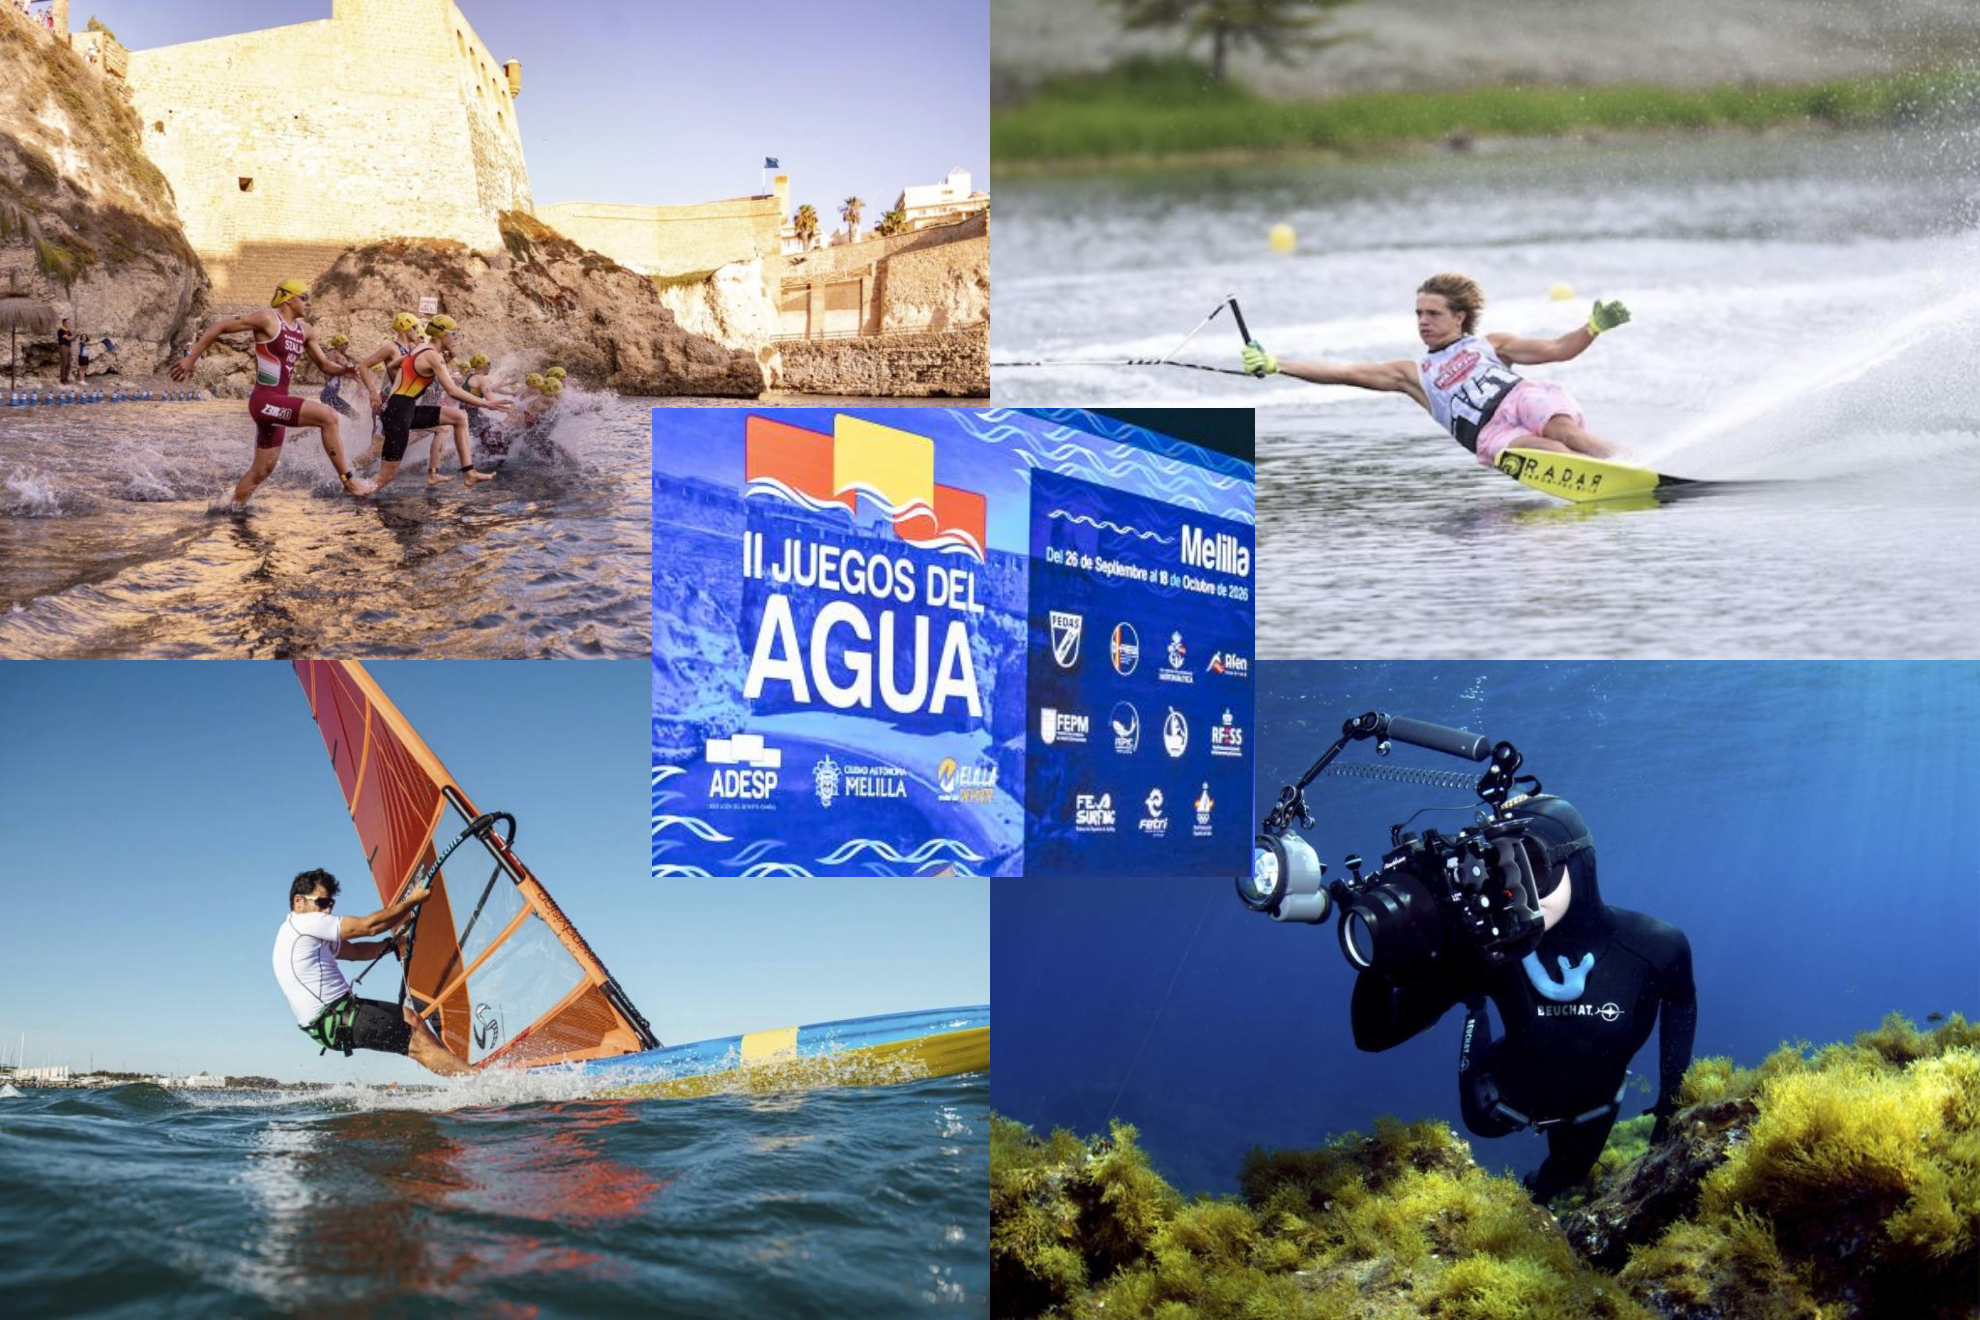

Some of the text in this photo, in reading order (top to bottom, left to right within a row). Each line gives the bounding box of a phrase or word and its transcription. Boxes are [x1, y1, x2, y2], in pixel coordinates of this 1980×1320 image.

[1525, 458, 1603, 489] RADAR
[1180, 524, 1251, 578] Melilla
[742, 530, 986, 614] II JUEGOS DEL
[1045, 545, 1064, 565] Del
[1064, 549, 1079, 568] 26
[1080, 554, 1094, 570] de
[1094, 556, 1148, 581] Septiembre
[1149, 568, 1158, 584] al
[1169, 572, 1181, 588] de
[1181, 574, 1216, 595] Octubre
[1228, 584, 1249, 602] 2026
[1051, 614, 1081, 629] FEDAS
[742, 592, 984, 718] AGUA
[1056, 713, 1090, 734] FEPM
[708, 769, 779, 800] ADESP
[844, 776, 908, 798] MELILLA
